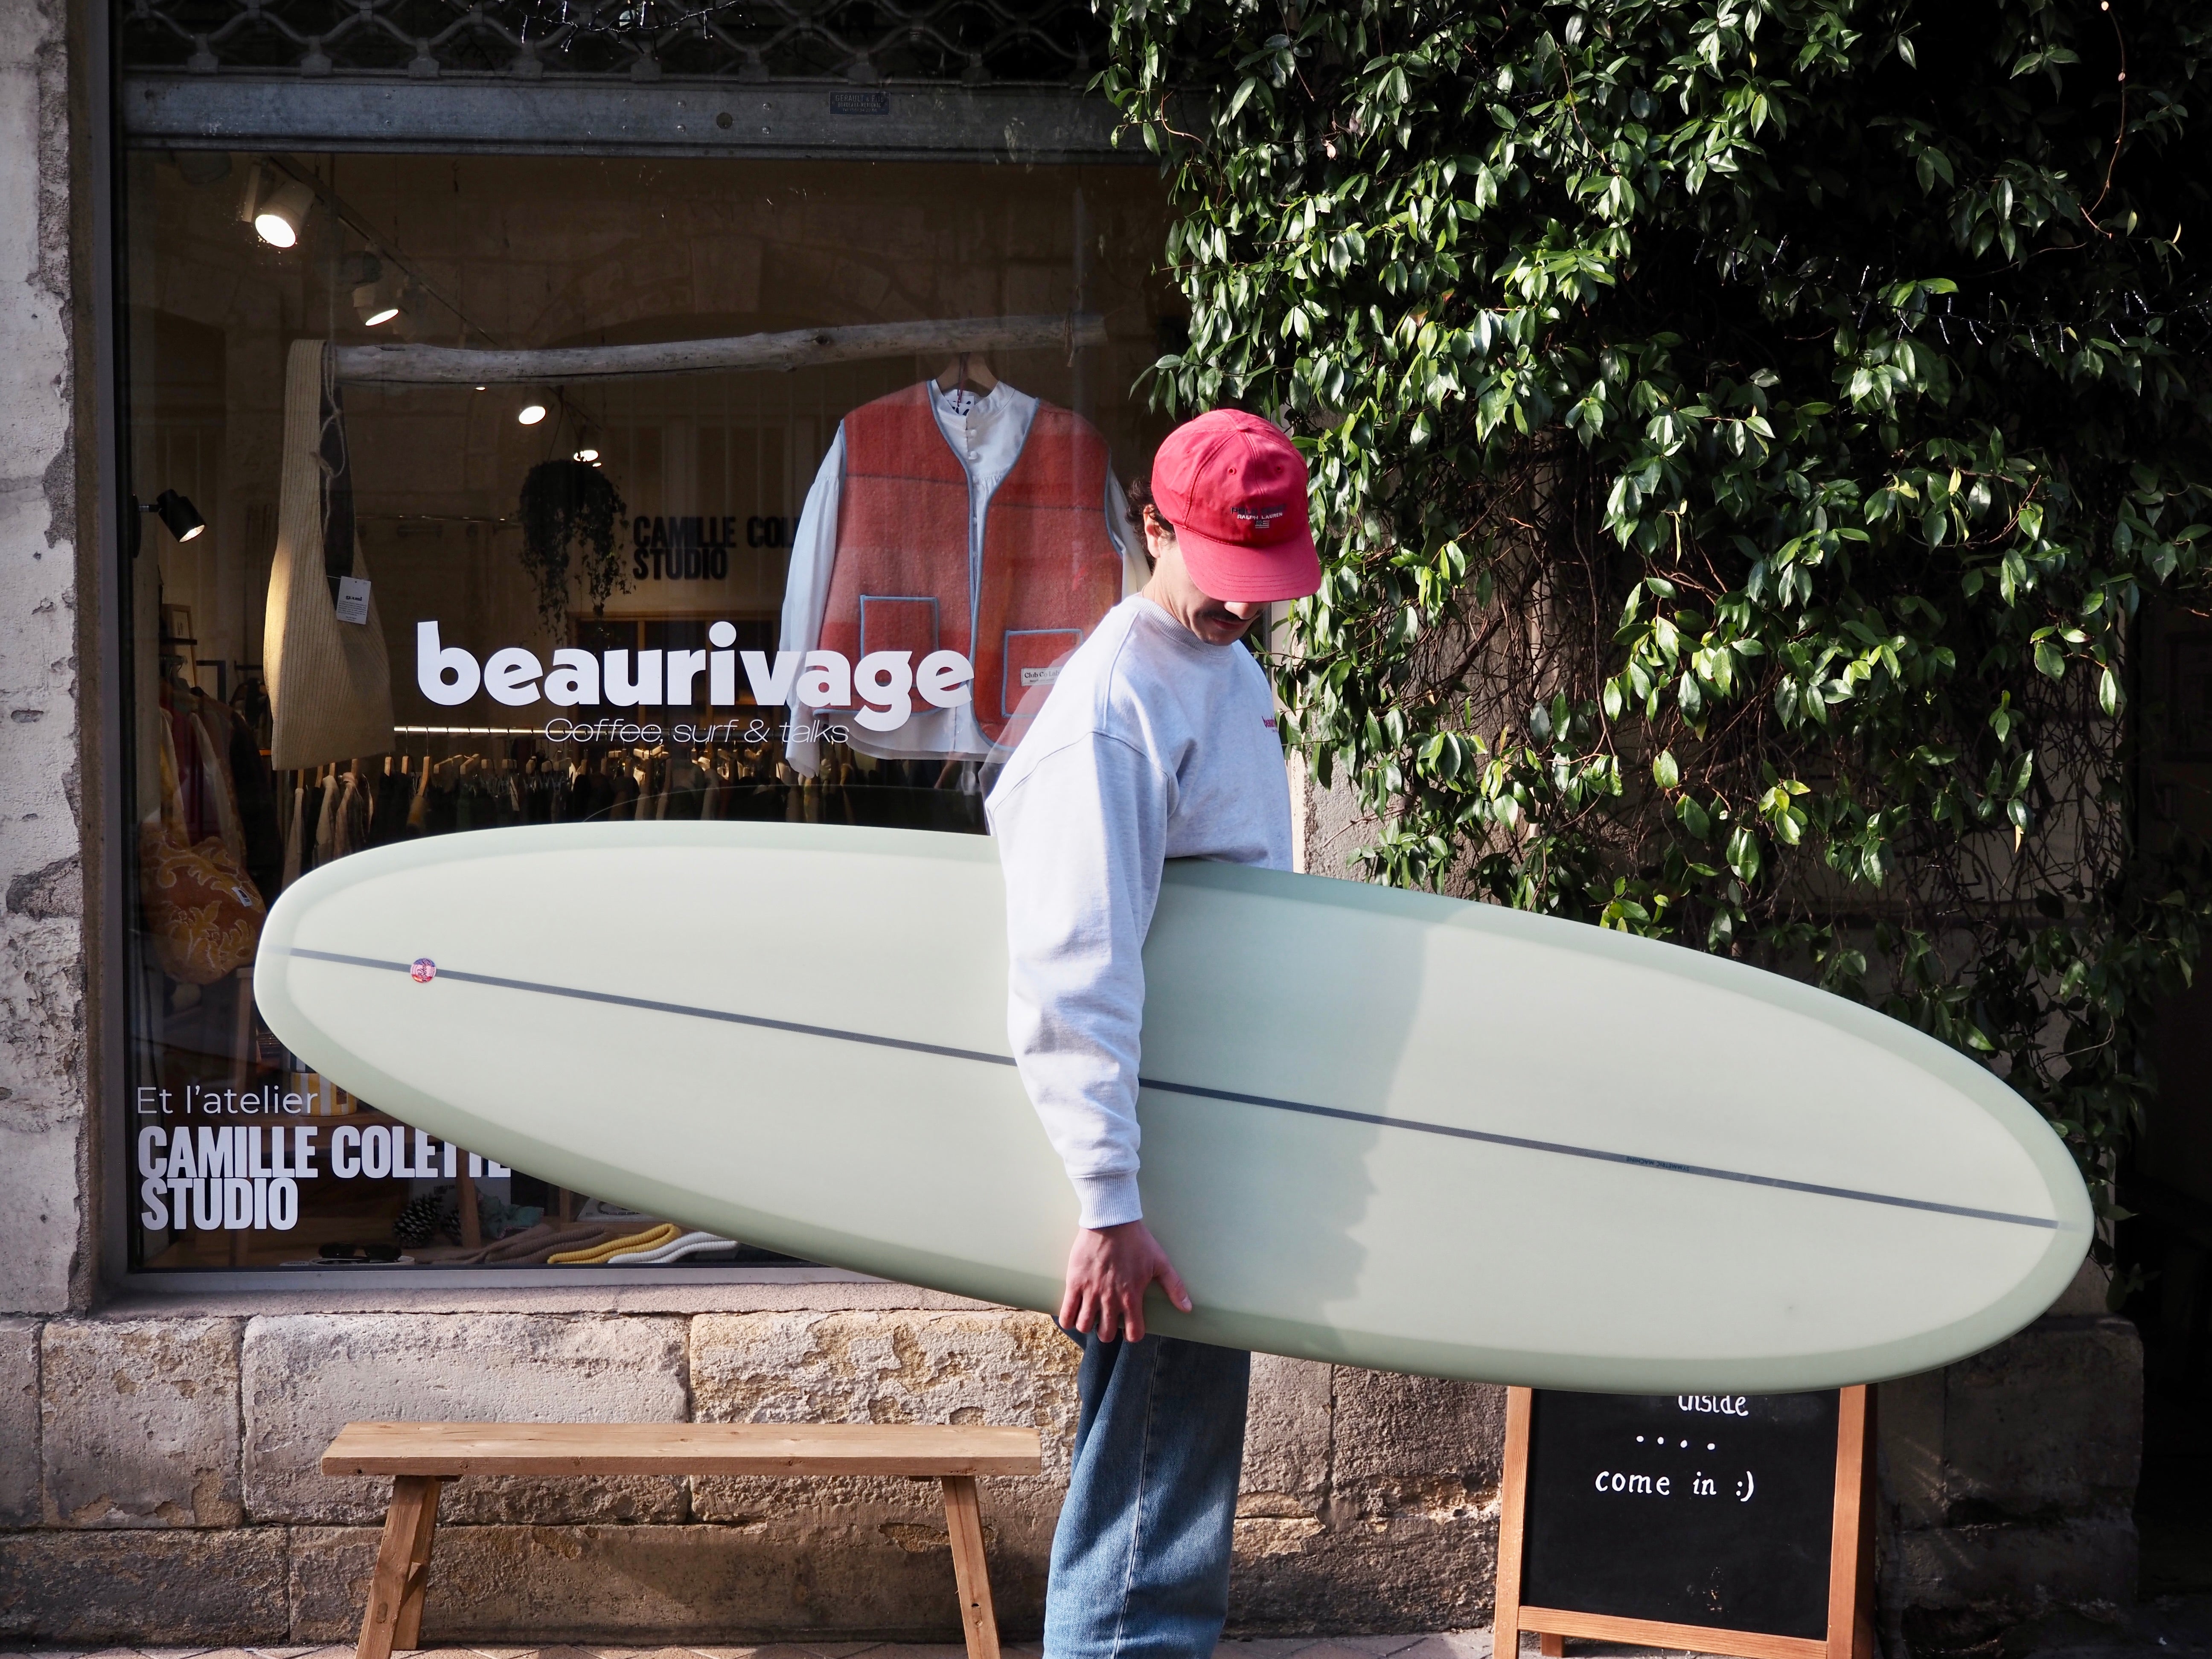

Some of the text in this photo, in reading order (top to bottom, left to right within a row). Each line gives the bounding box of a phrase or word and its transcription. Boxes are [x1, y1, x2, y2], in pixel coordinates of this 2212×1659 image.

[633, 516, 736, 547] CAMILLE
[633, 548, 727, 580] STUDIO
[417, 620, 975, 732] beaurivage
[545, 718, 850, 745] Coffee, surf & talks
[137, 1085, 318, 1114] Et l’atelier
[138, 1126, 318, 1178] CAMILLE
[1626, 1156, 1689, 1171] SYMMETRIC MACHINE
[141, 1178, 298, 1231] STUDIO
[1595, 1470, 1670, 1496] come
[1693, 1471, 1717, 1495] in
